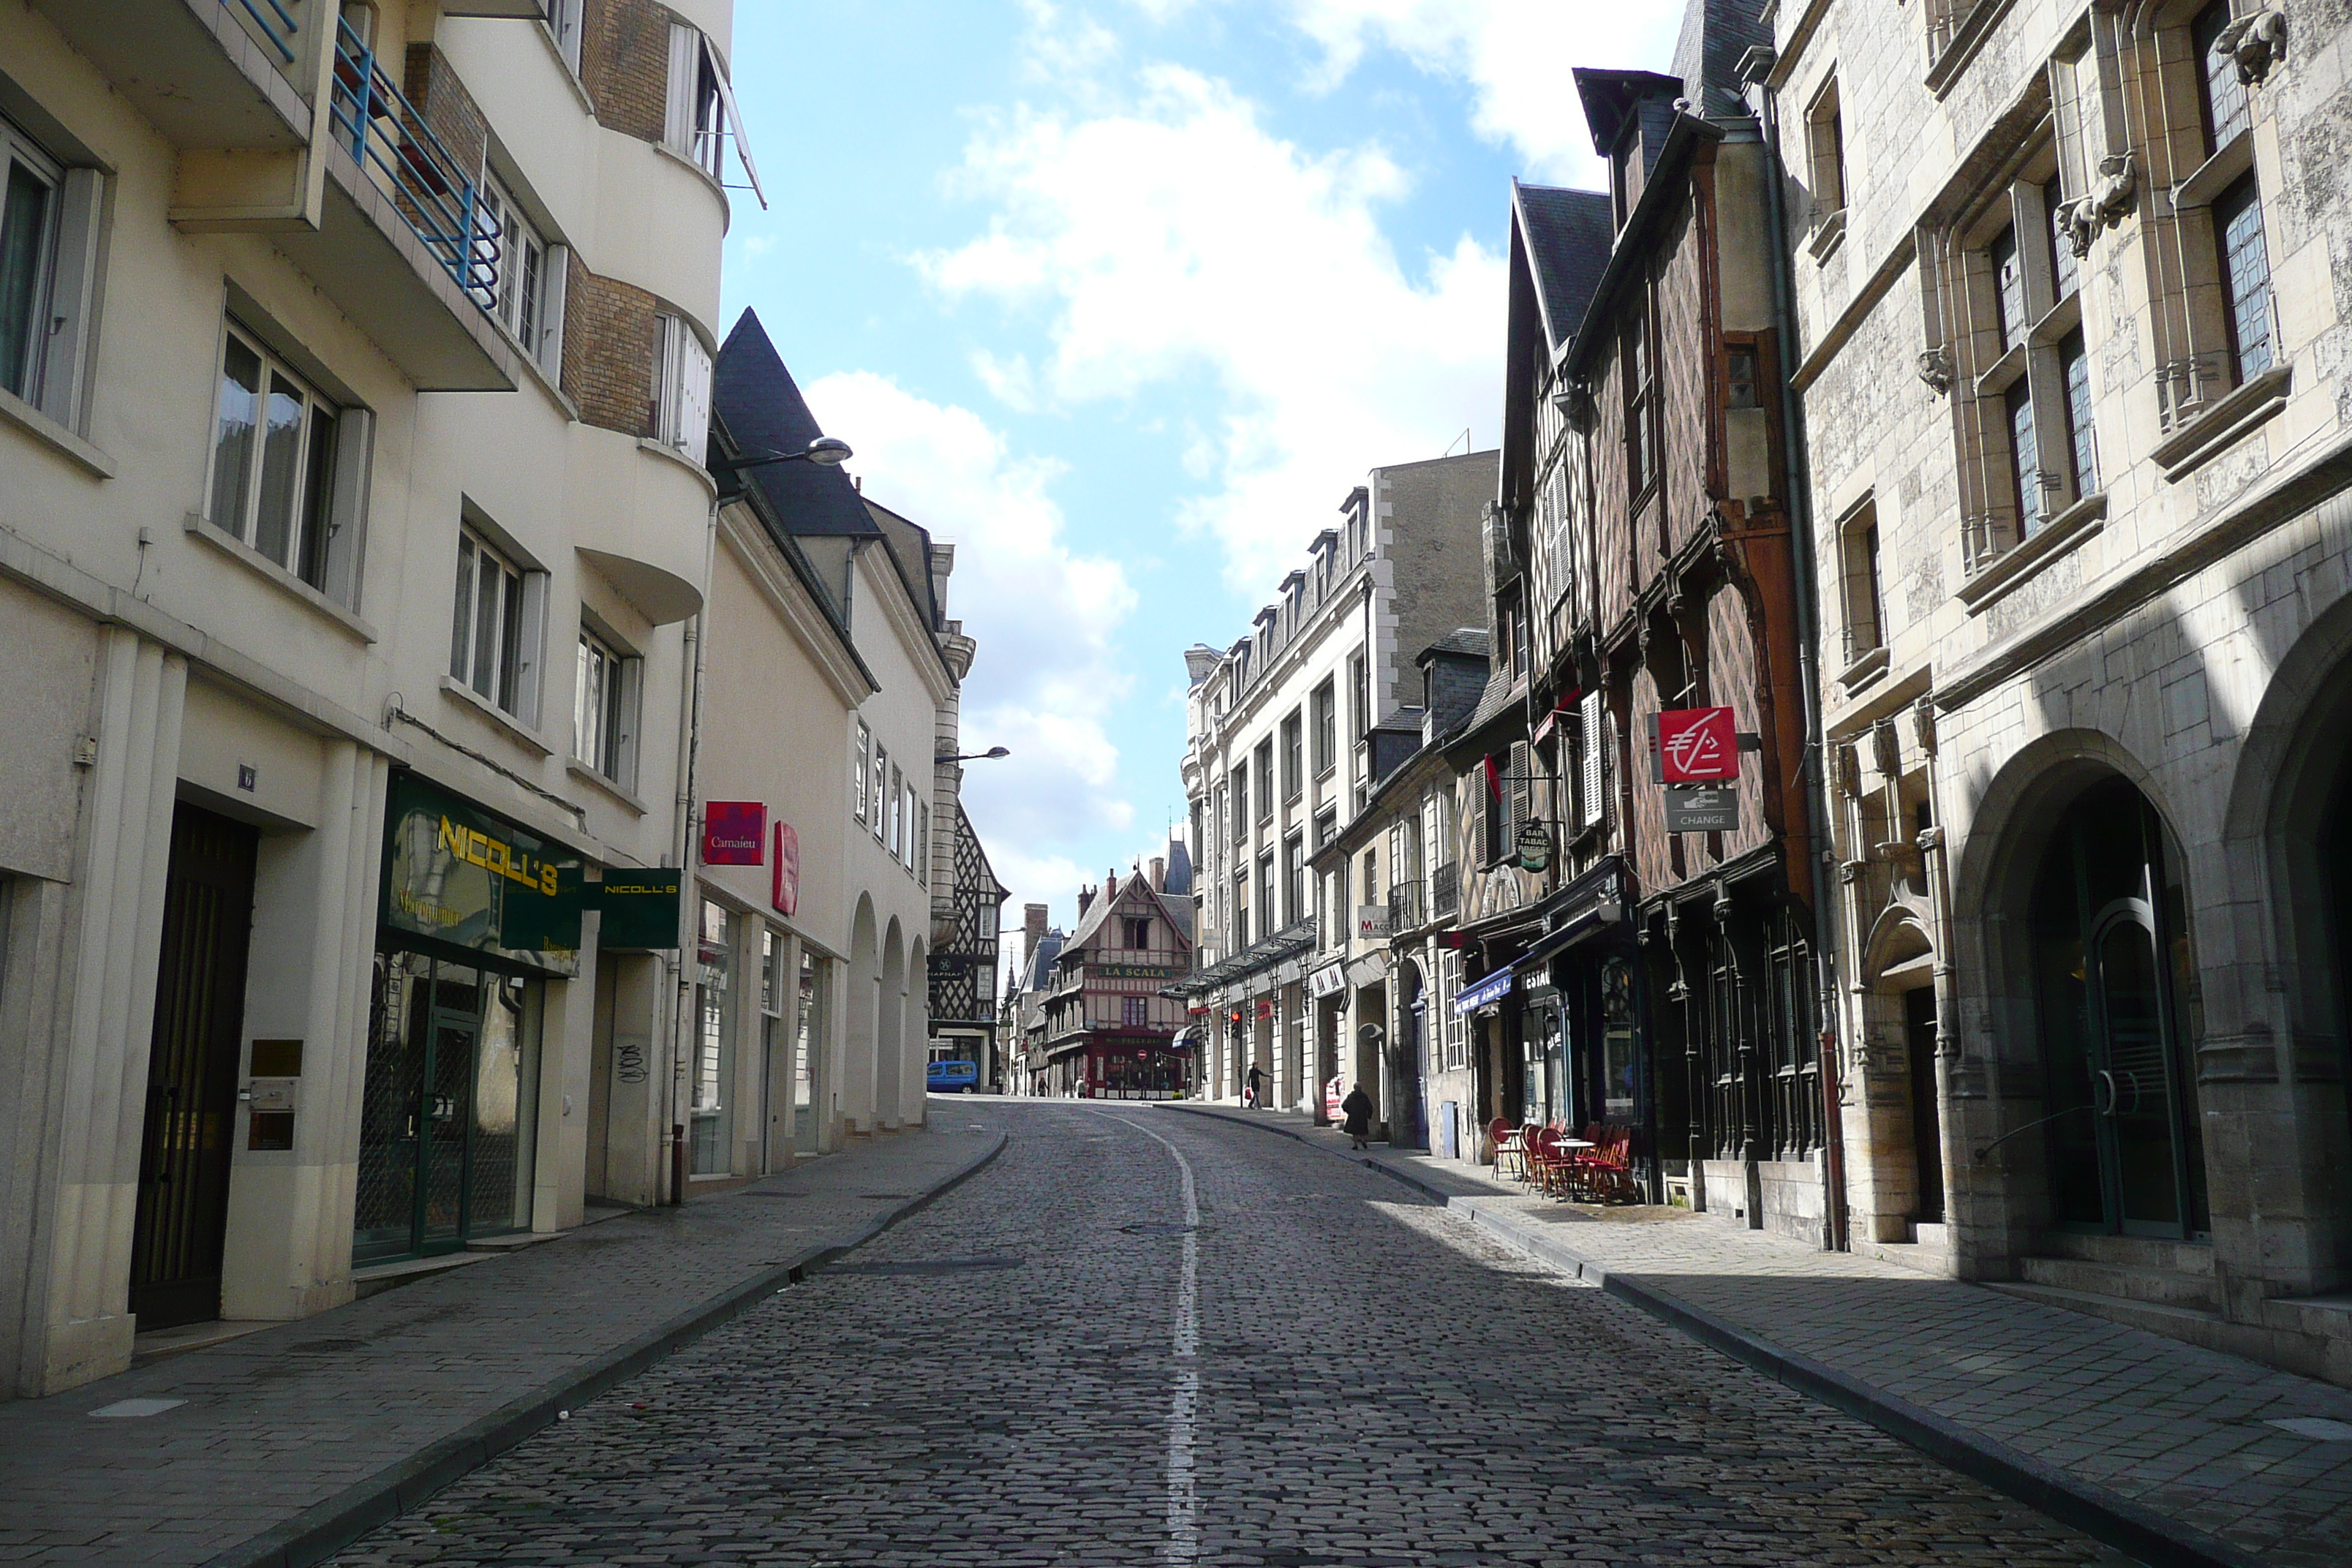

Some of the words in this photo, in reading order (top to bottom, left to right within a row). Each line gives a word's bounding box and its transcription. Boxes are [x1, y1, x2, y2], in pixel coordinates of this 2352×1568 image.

[1680, 815, 1726, 825] CHANGE
[1519, 837, 1548, 846] TABAC
[1518, 845, 1552, 854] PRESSE
[437, 814, 558, 897] NICOLL'S
[604, 885, 677, 894] NICOLL'S
[1105, 967, 1120, 976] LA
[1125, 968, 1165, 977] SCALA
